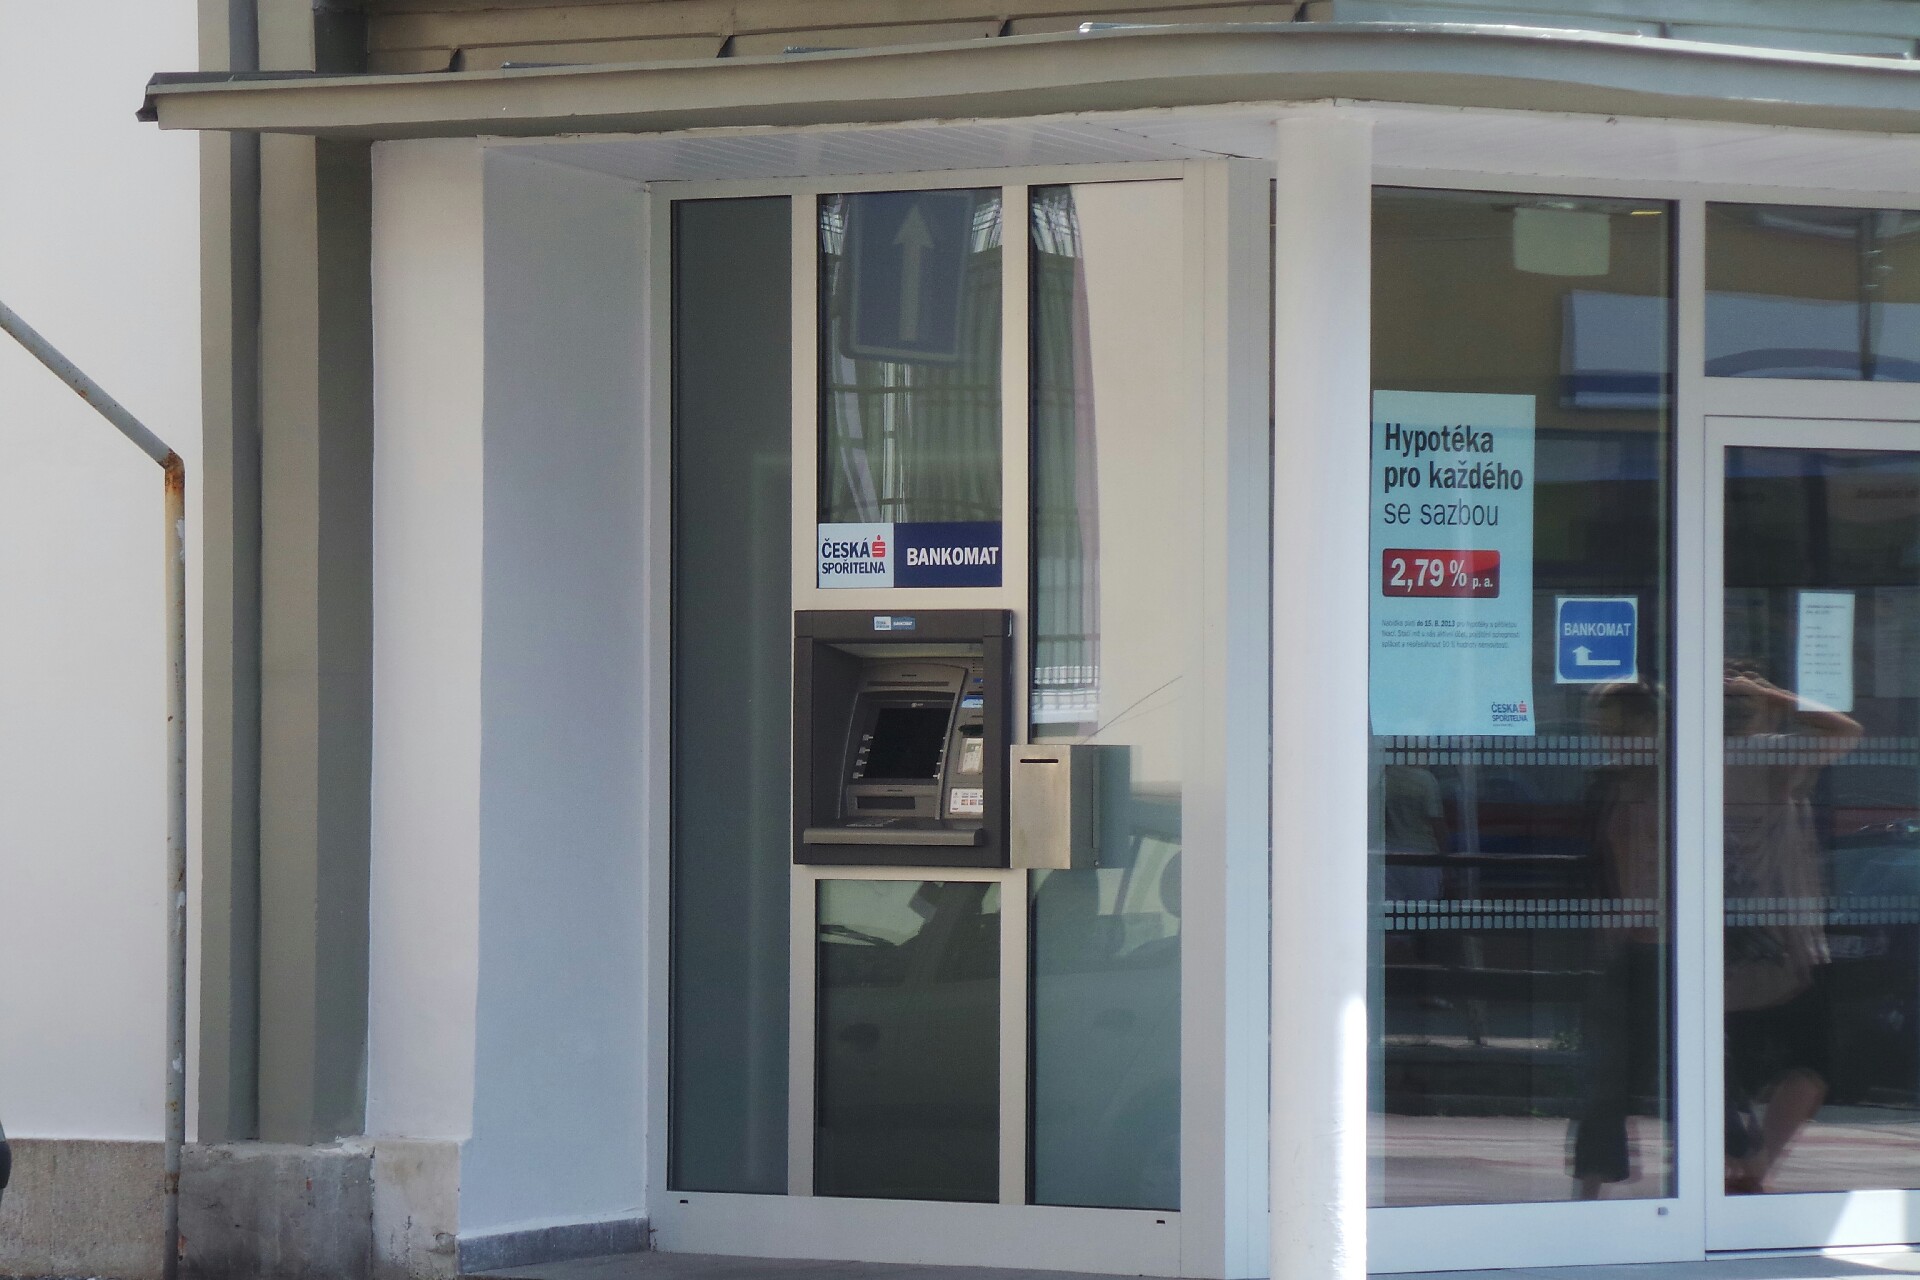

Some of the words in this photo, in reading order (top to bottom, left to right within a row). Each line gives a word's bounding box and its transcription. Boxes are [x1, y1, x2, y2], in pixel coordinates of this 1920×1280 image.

[1385, 422, 1494, 458] Hypotéka
[1384, 466, 1421, 494] pro
[1429, 460, 1524, 491] každého
[1384, 502, 1411, 525] se
[1420, 498, 1499, 526] sazbou
[821, 537, 871, 559] ČESKÁ
[906, 546, 999, 566] BANKOMAT
[821, 559, 886, 575] SPOŘITELNA
[1441, 619, 1456, 628] 2013
[1564, 622, 1632, 636] BANKOMAT
